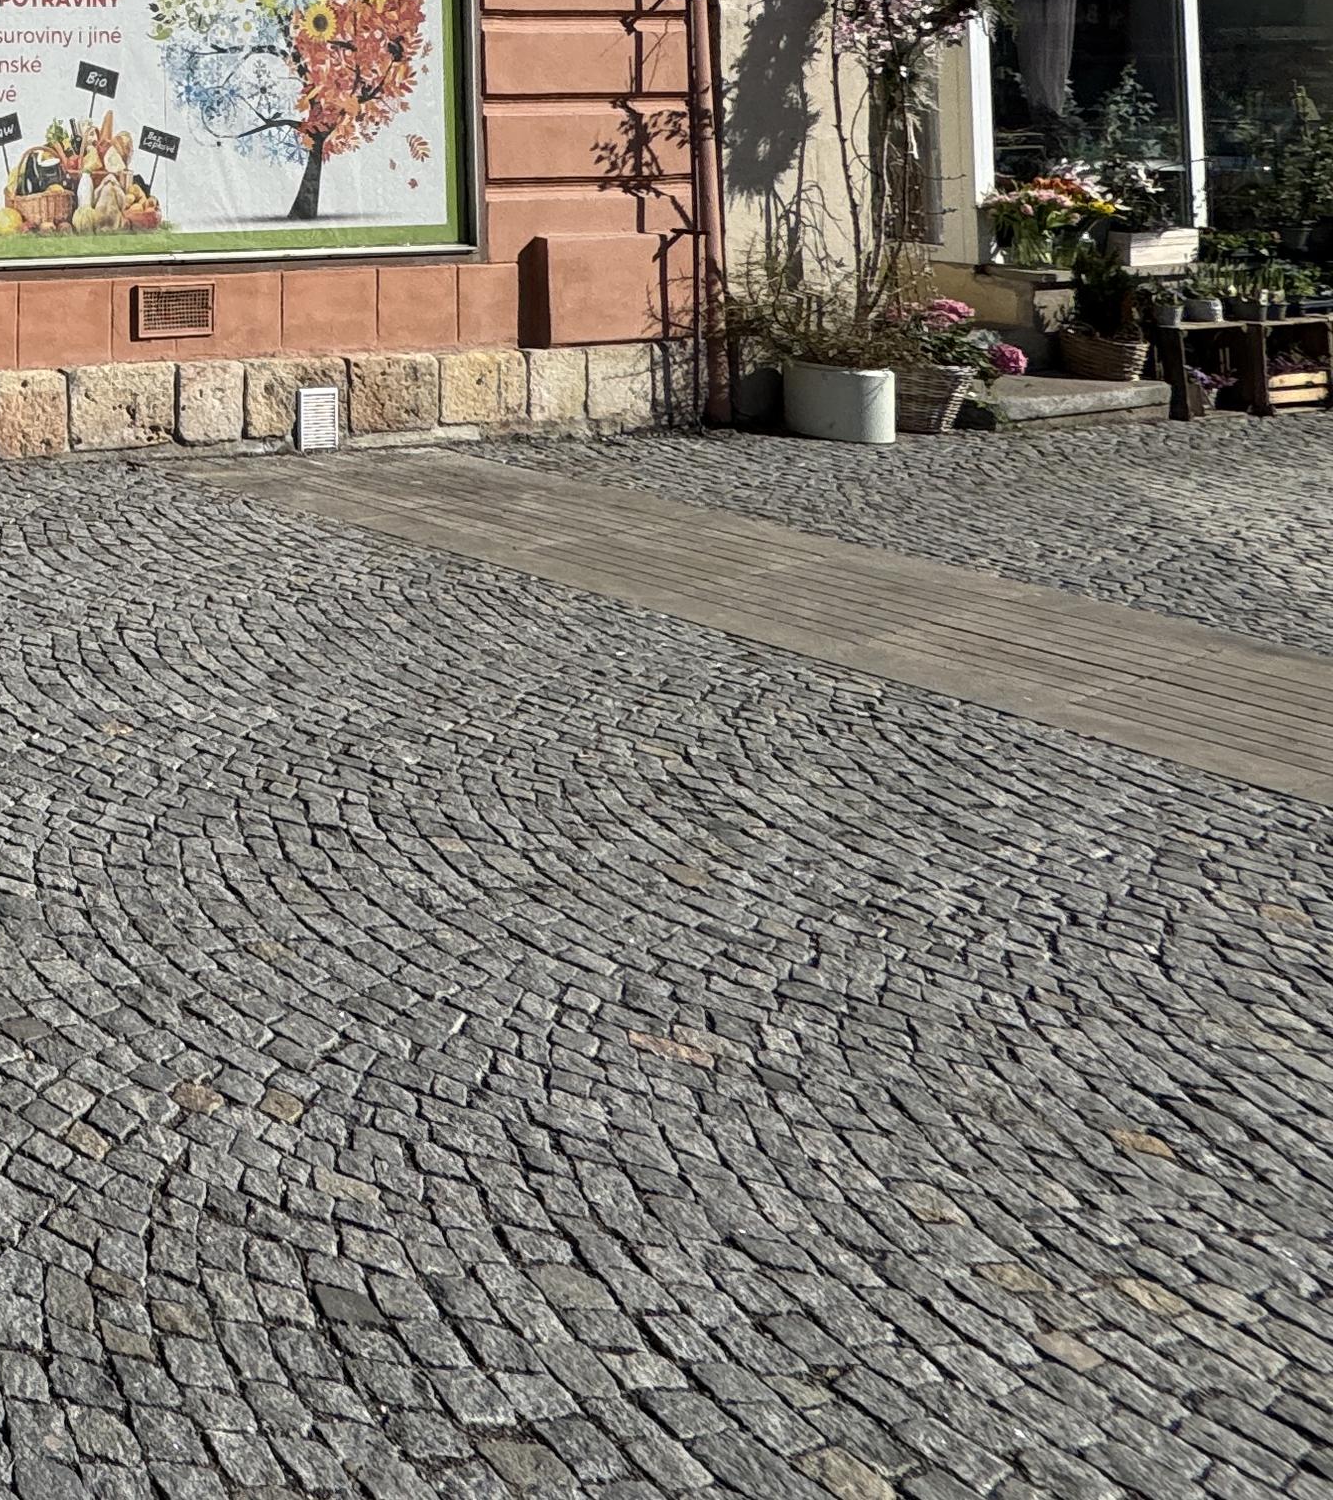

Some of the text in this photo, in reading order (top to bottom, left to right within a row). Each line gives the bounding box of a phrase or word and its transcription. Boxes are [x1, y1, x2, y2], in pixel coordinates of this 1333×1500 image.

[77, 26, 83, 44] i
[85, 26, 122, 49] jiné
[86, 71, 108, 88] Bio
